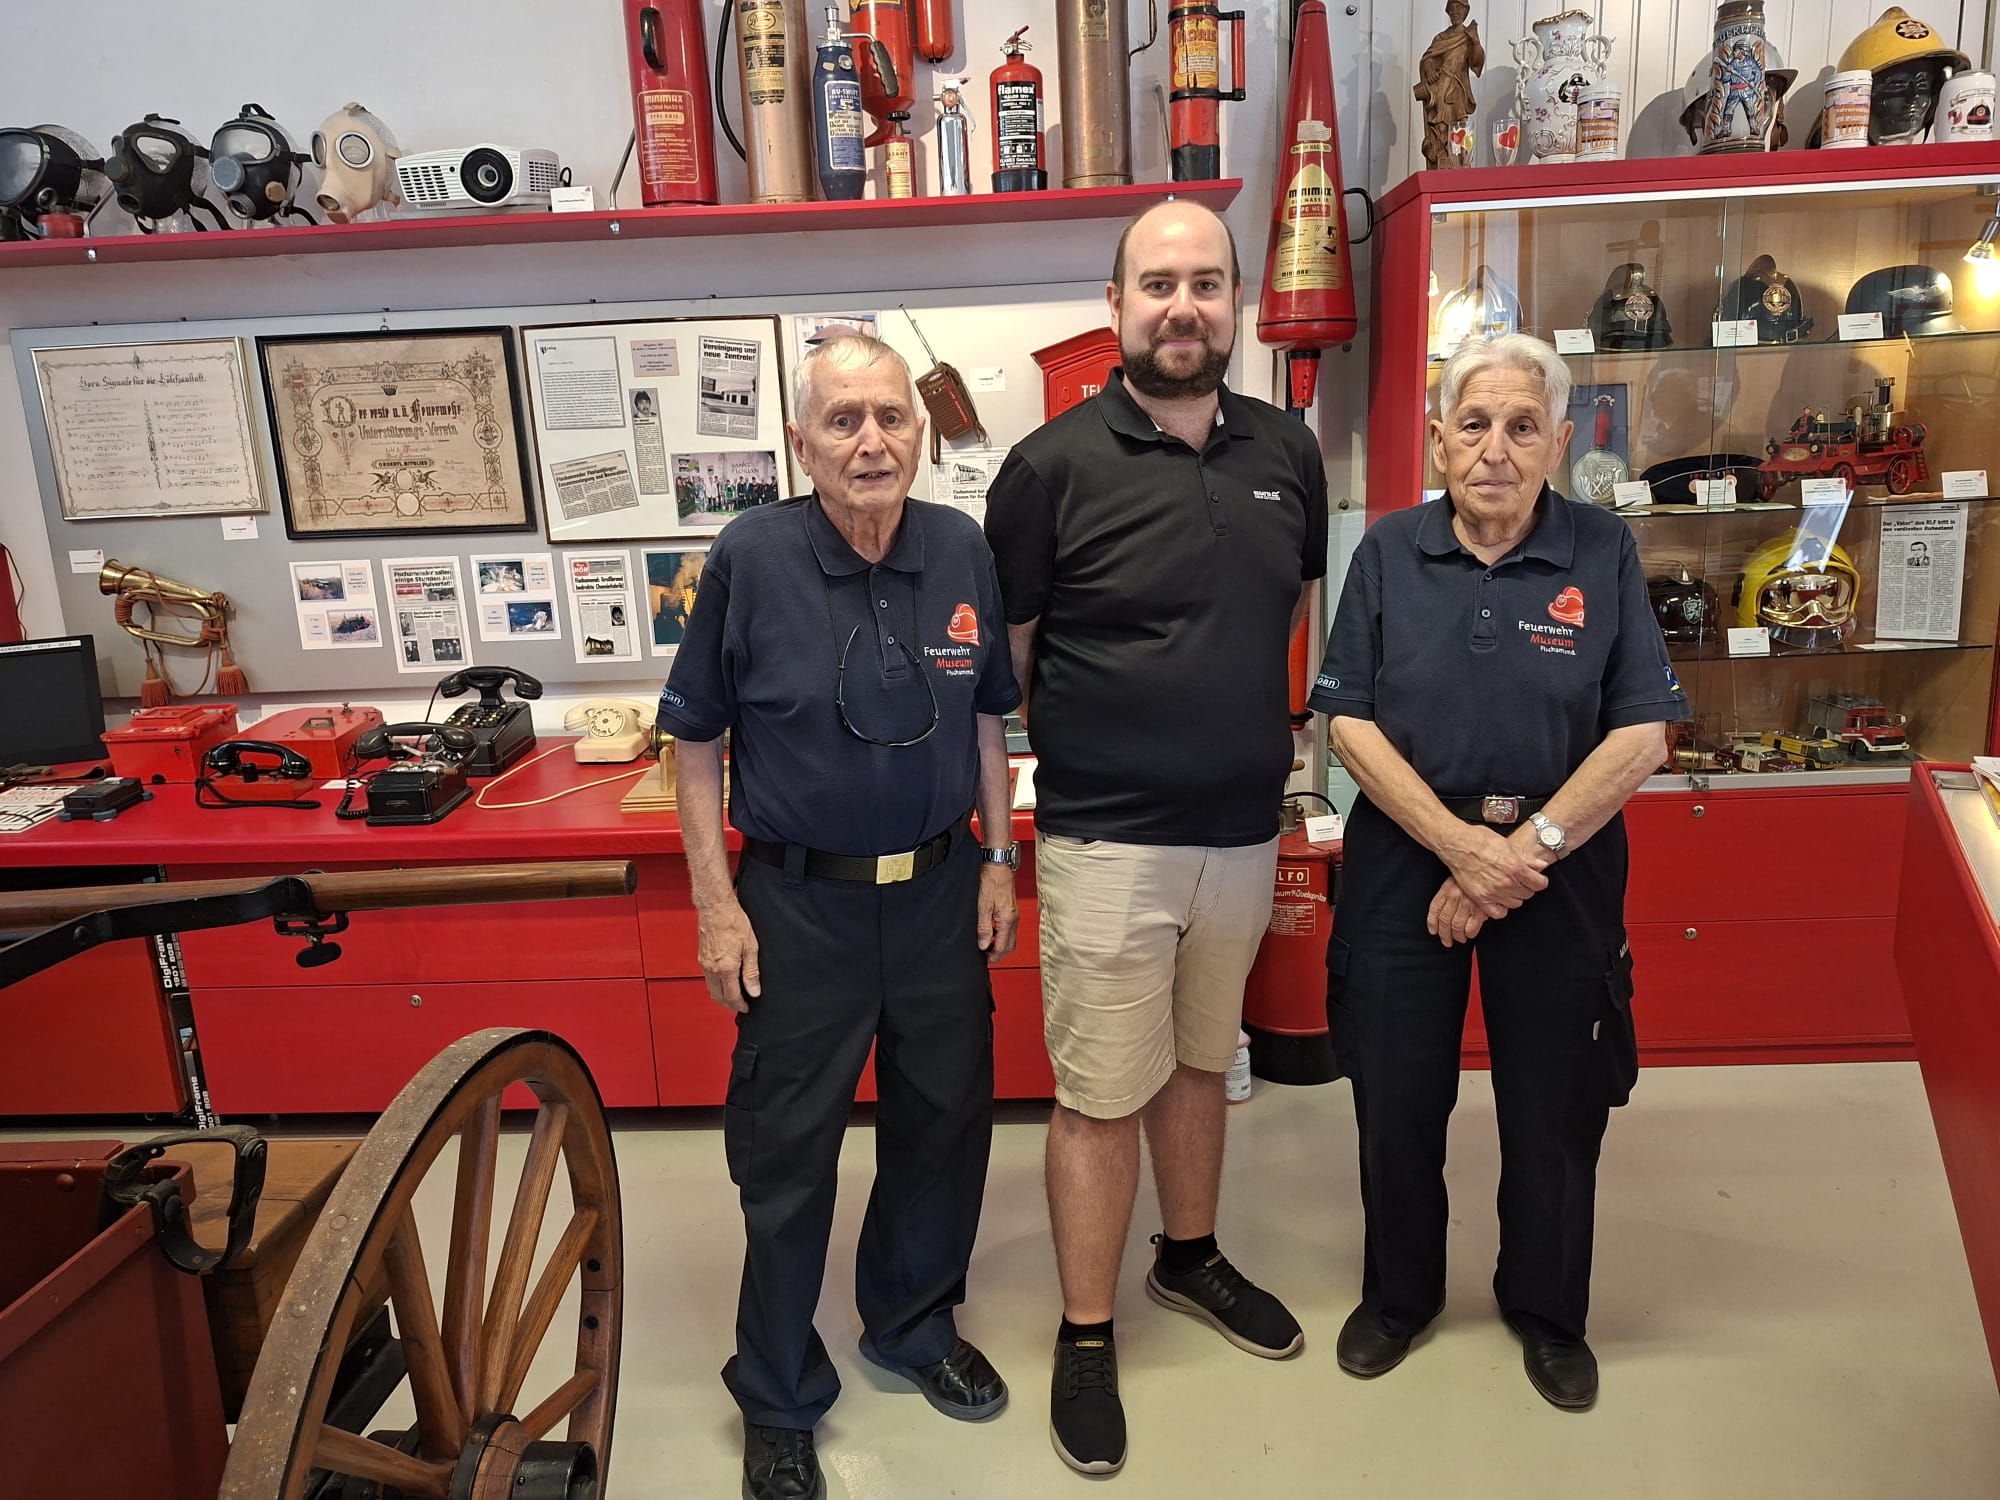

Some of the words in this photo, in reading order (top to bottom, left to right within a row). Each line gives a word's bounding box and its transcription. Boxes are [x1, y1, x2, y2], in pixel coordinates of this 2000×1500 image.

[997, 84, 1035, 95] flamex
[644, 94, 683, 103] minimax
[1288, 187, 1332, 198] mnimx
[703, 343, 743, 353] Vereinigung
[703, 351, 721, 359] neue
[1518, 620, 1575, 637] Feuerwehr
[1529, 633, 1575, 648] Museum
[923, 646, 971, 657] Feuerwehr
[936, 658, 973, 669] Museum
